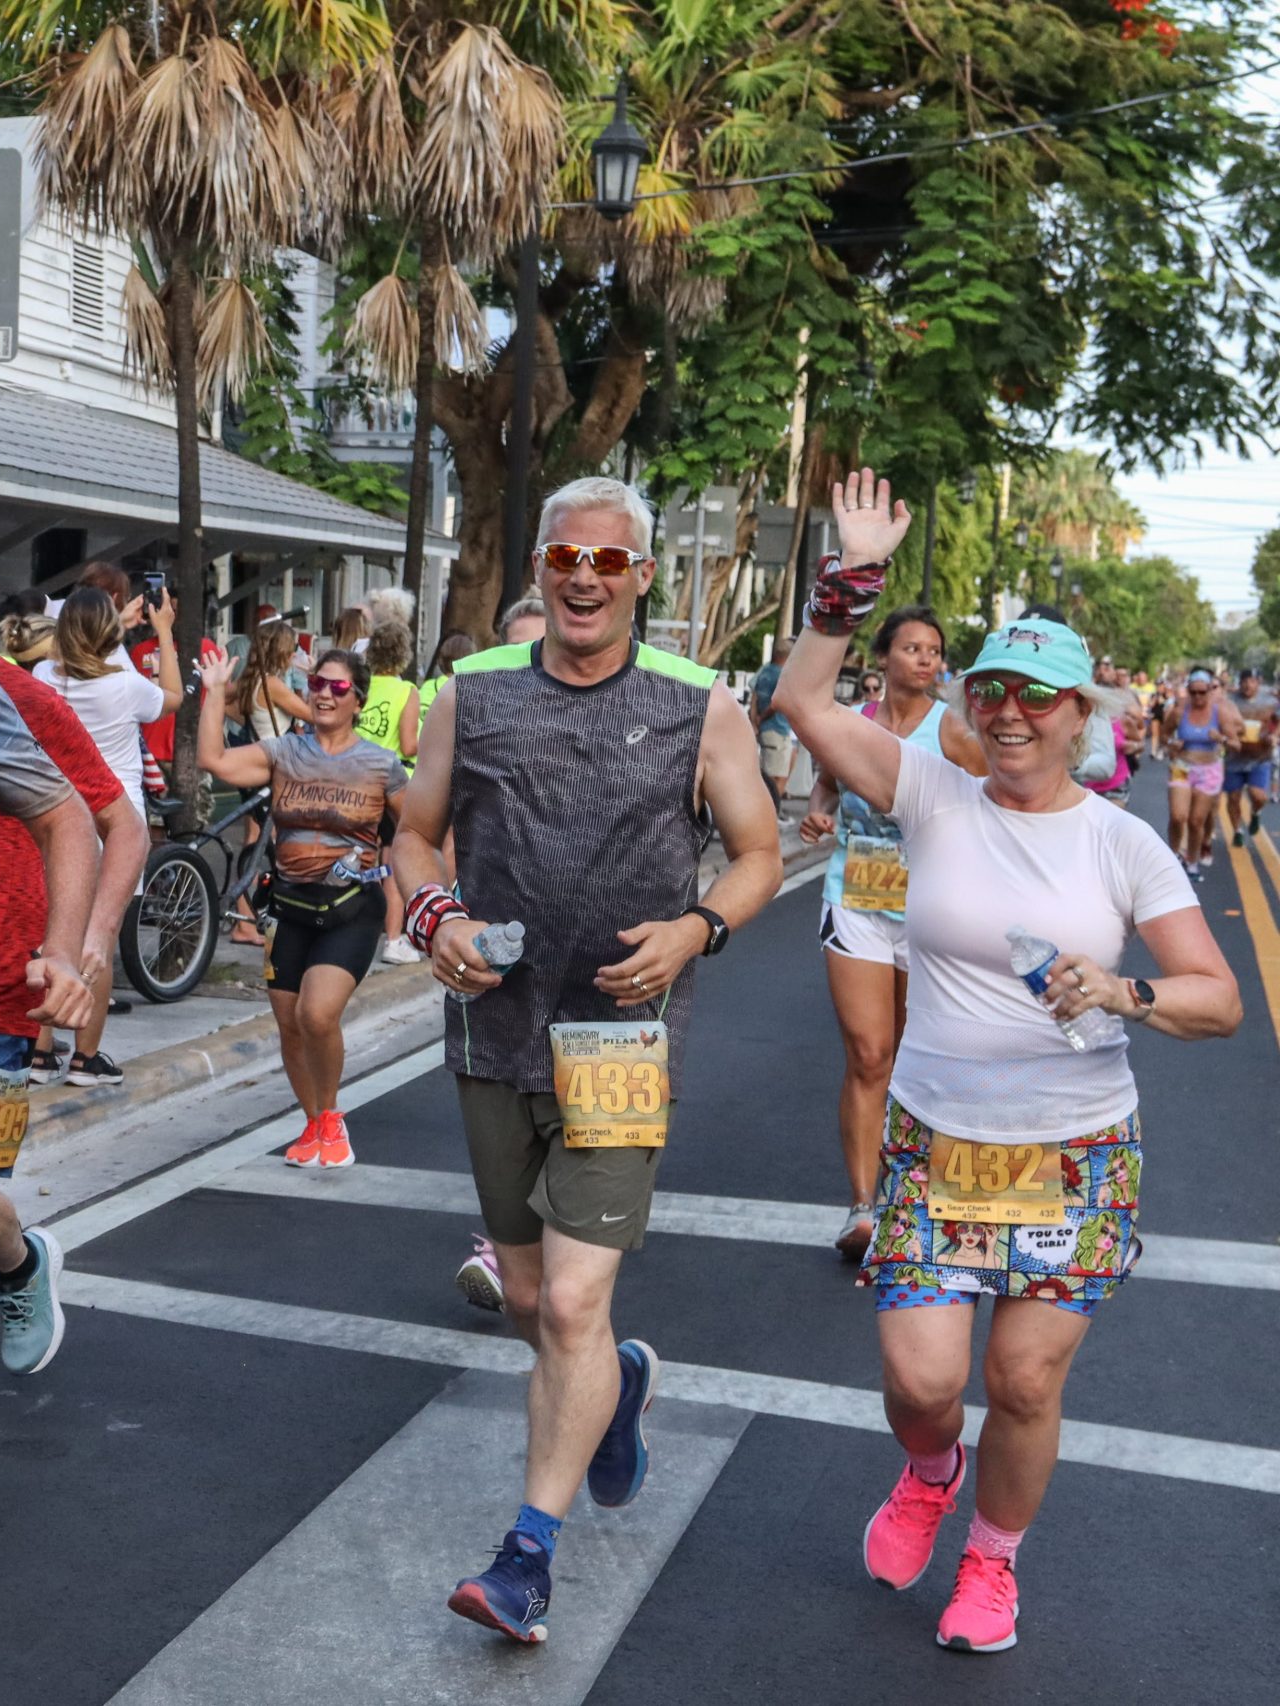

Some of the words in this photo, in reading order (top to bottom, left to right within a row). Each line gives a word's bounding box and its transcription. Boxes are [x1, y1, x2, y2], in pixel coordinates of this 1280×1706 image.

[277, 781, 368, 808] HEMINGWAY
[566, 1062, 662, 1115] 433
[571, 1127, 587, 1137] Gear
[589, 1127, 613, 1137] Check
[624, 1131, 640, 1140] 433
[584, 1136, 599, 1145] 433
[944, 1142, 1046, 1193] 432
[947, 1204, 965, 1212] Gear
[962, 1212, 977, 1220] 432
[1005, 1209, 1022, 1217] 432
[1039, 1209, 1056, 1217] 432
[1027, 1229, 1052, 1239] YOU
[1056, 1228, 1073, 1236] GO
